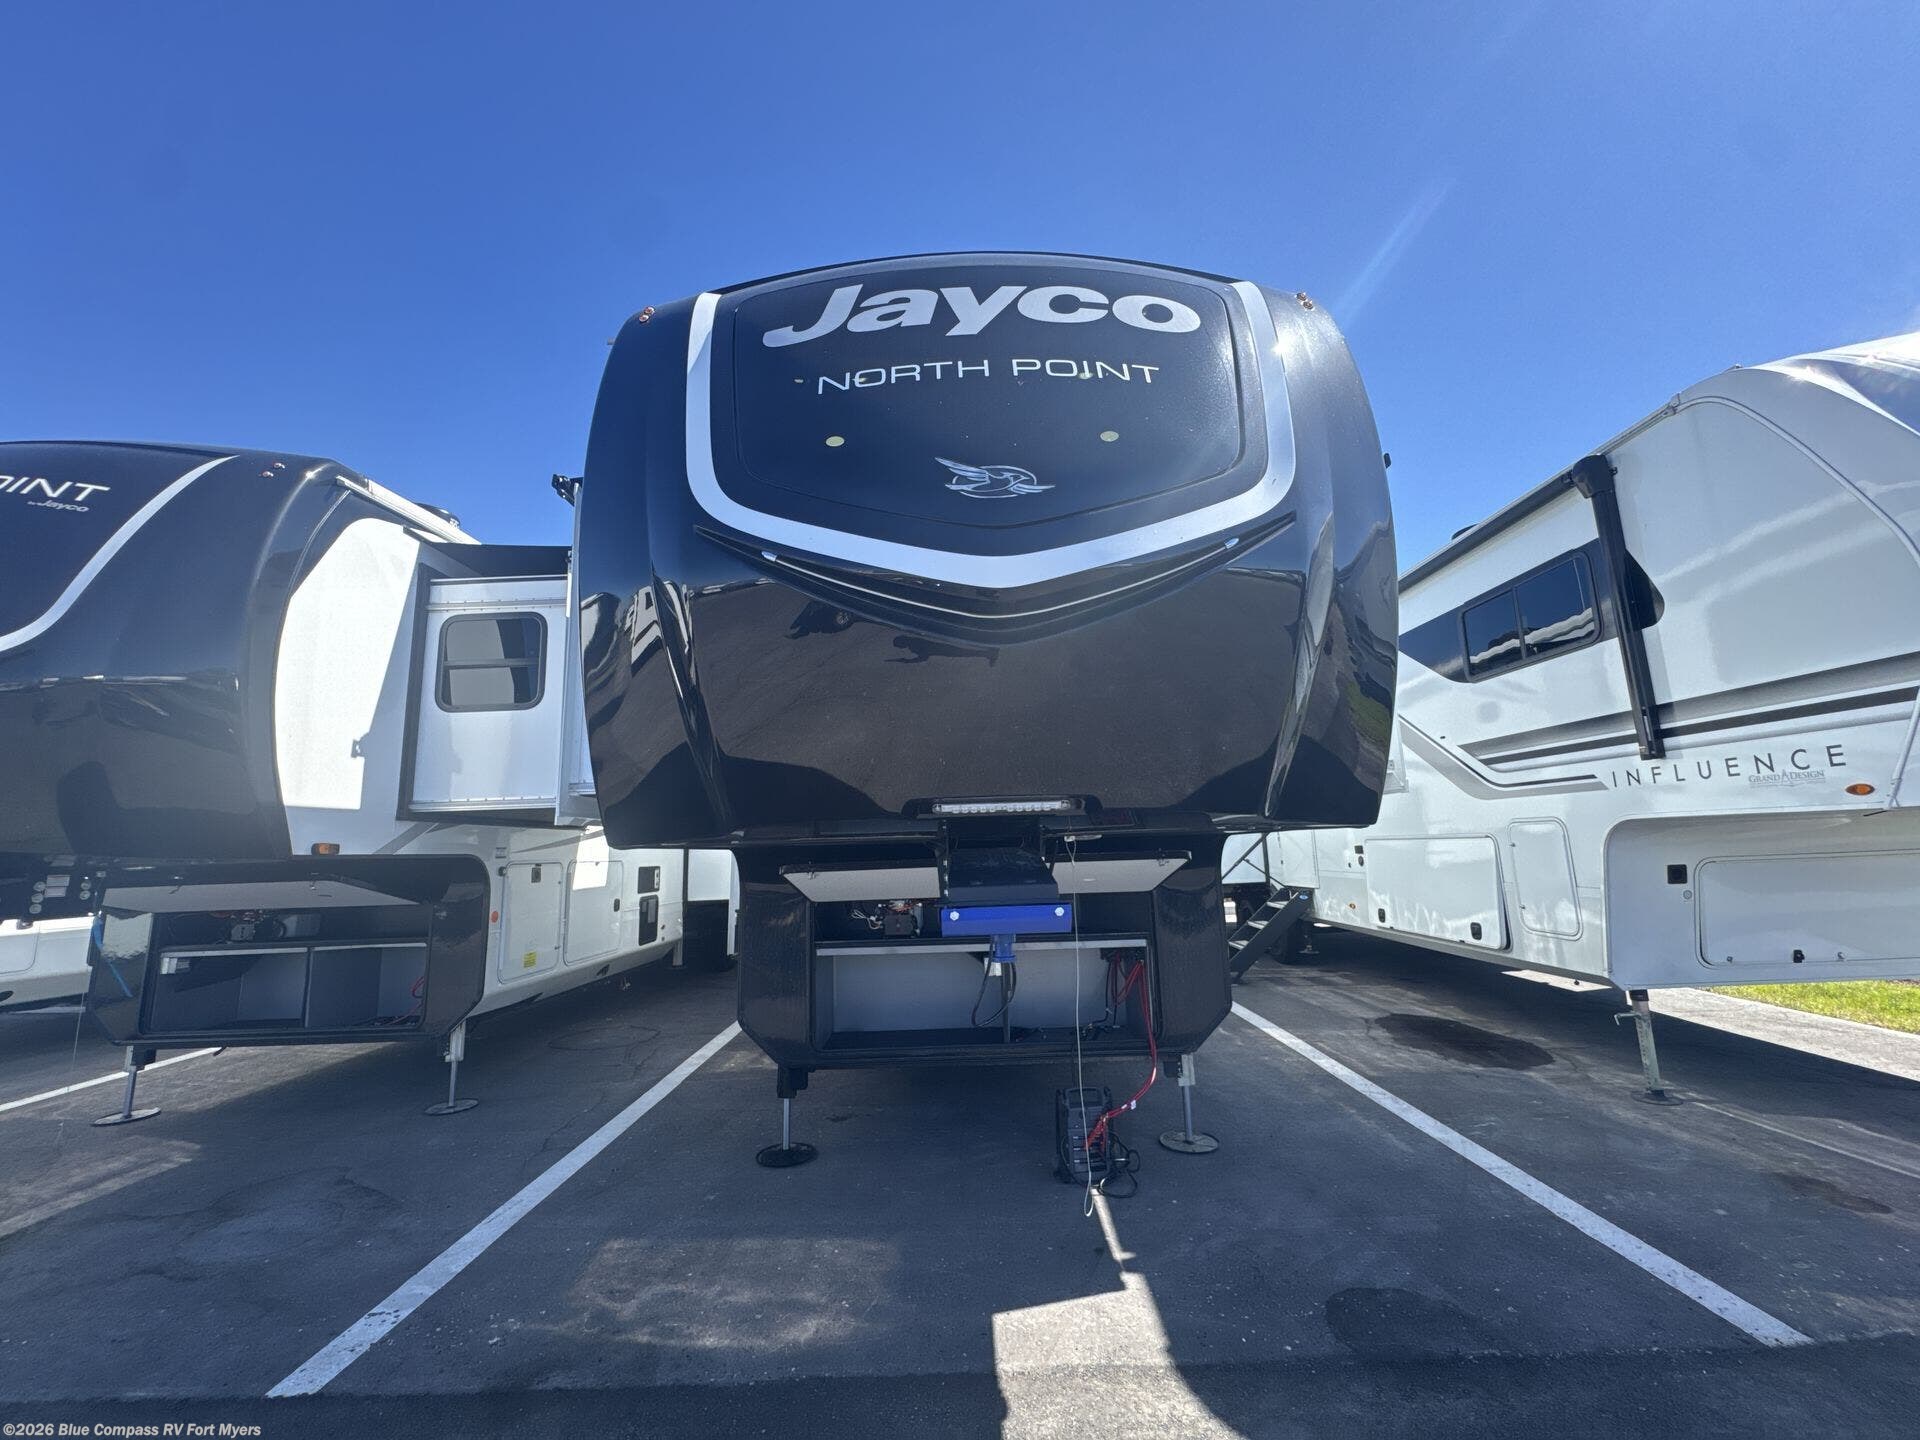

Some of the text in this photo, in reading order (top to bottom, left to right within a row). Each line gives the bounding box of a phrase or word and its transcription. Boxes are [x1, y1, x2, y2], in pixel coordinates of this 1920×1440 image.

[762, 283, 1202, 348] Jayco
[817, 358, 1160, 395] NORTH POINT
[38, 499, 90, 512] Jayco
[1612, 743, 1847, 788] INFLUENCE
